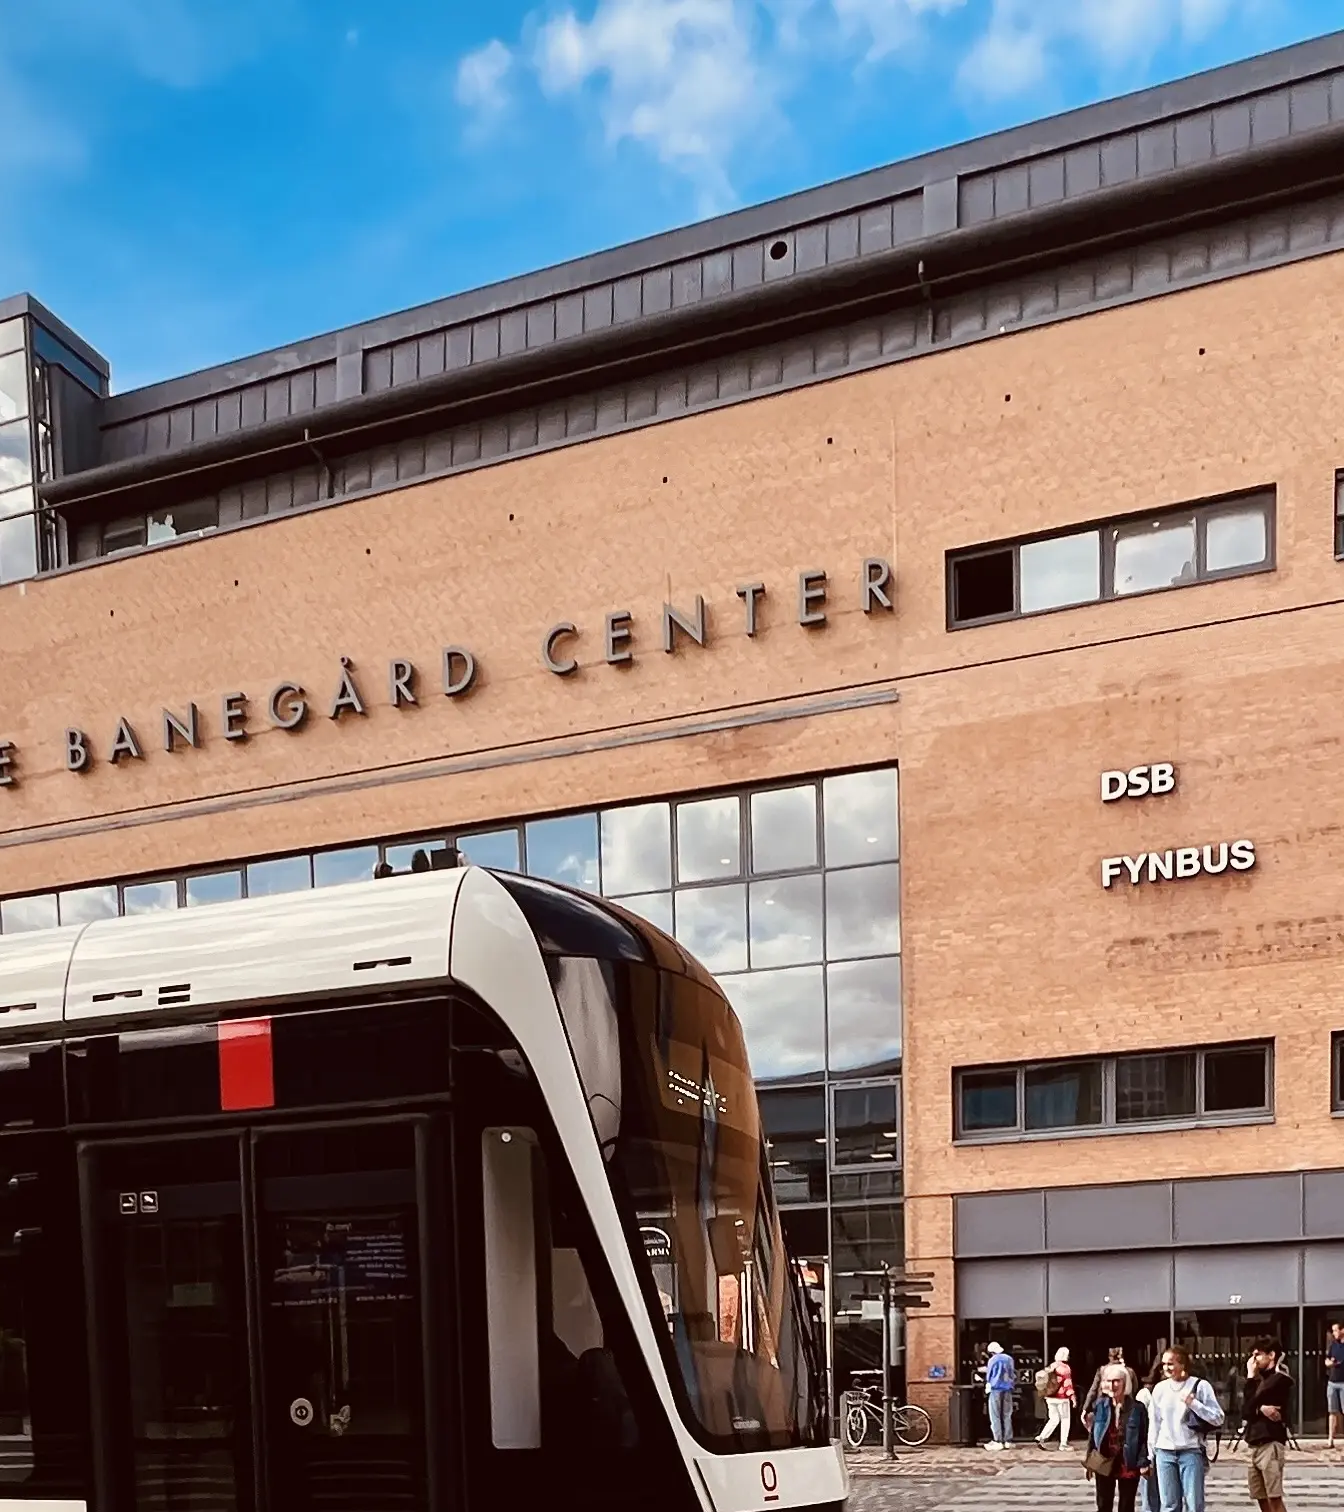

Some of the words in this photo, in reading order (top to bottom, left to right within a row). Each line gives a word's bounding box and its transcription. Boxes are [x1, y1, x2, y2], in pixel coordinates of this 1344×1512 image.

[65, 644, 476, 773] BANEGÅRD
[543, 557, 895, 675] CENTER
[1101, 763, 1175, 802] DSB
[1101, 840, 1256, 888] FYNBUS
